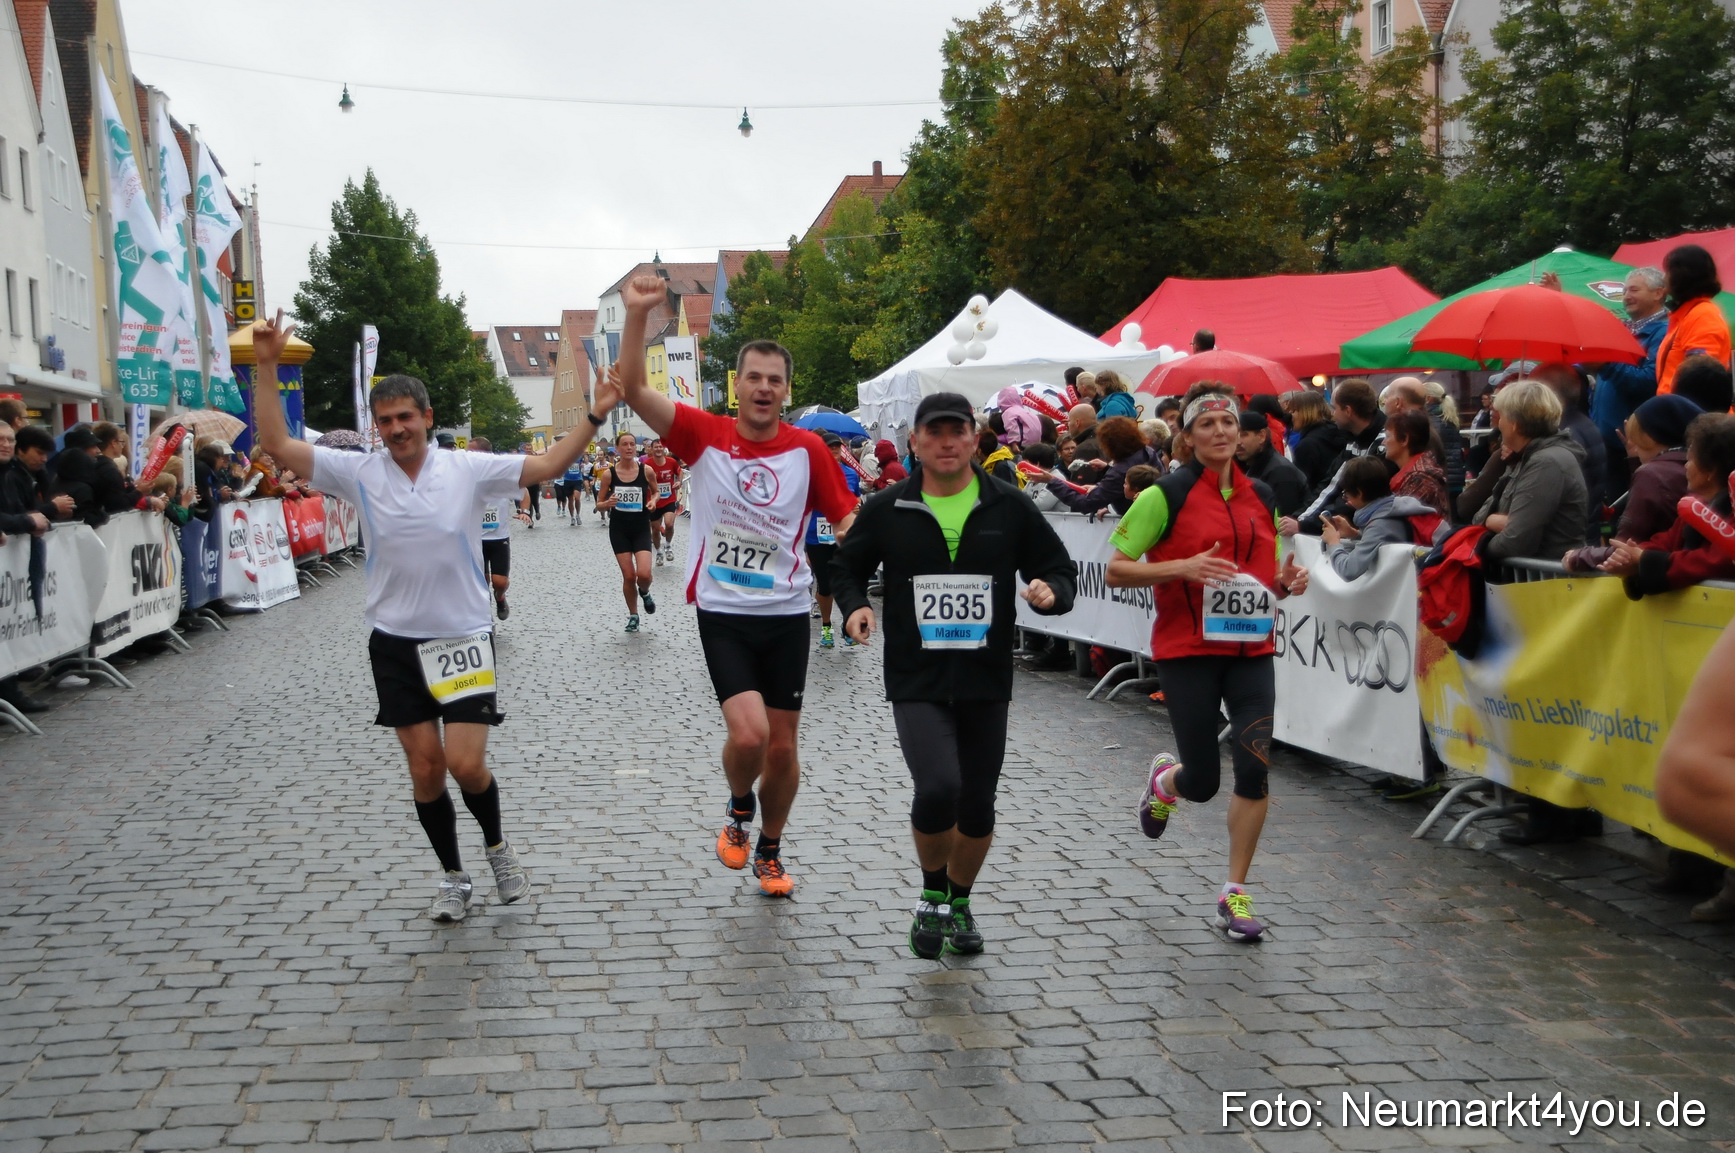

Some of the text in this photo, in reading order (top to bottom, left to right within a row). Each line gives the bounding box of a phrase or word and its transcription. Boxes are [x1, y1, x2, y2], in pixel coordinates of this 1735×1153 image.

[130, 383, 159, 397] 635
[589, 444, 595, 452] D
[617, 493, 640, 503] 2837
[482, 512, 497, 523] 86
[820, 524, 832, 535] 21
[714, 529, 768, 548] PARTL Neumarkt
[716, 541, 771, 571] 2127
[731, 572, 751, 585] Willi
[1078, 560, 1107, 600] MW
[916, 582, 979, 590] PARTL Neumarkt
[922, 593, 986, 620] 2635
[1211, 590, 1270, 615] 2634
[935, 627, 971, 638] Markus
[1223, 621, 1257, 632] Andrea
[420, 636, 479, 656] PARTL Neumarkt
[1273, 608, 1335, 672] BKK
[437, 645, 483, 678] 290
[453, 676, 478, 691] Josef
